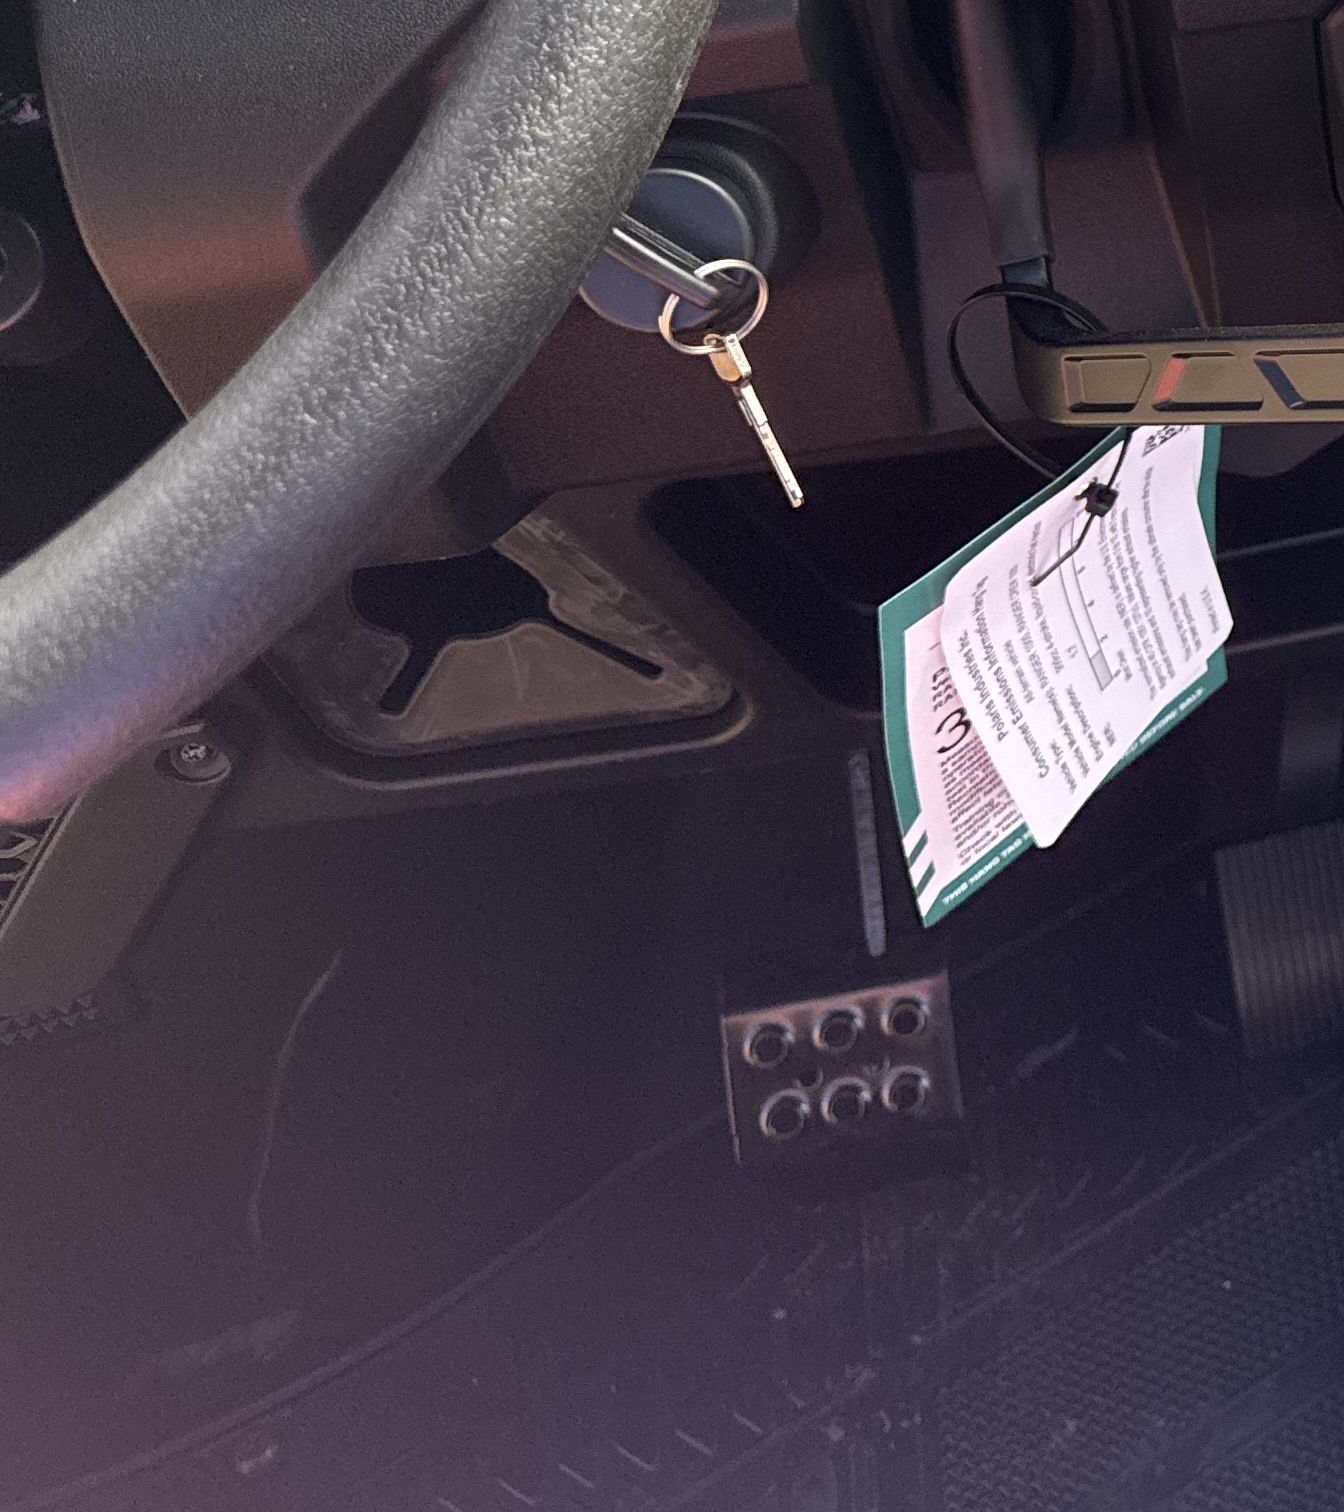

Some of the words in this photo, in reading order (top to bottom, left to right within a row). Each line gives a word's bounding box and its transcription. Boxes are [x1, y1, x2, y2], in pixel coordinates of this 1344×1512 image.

[973, 609, 998, 670] Information
[960, 646, 990, 704] Industries
[990, 664, 1023, 726] Emissions
[982, 697, 1008, 742] Polaris
[1016, 719, 1050, 780] Consumer
